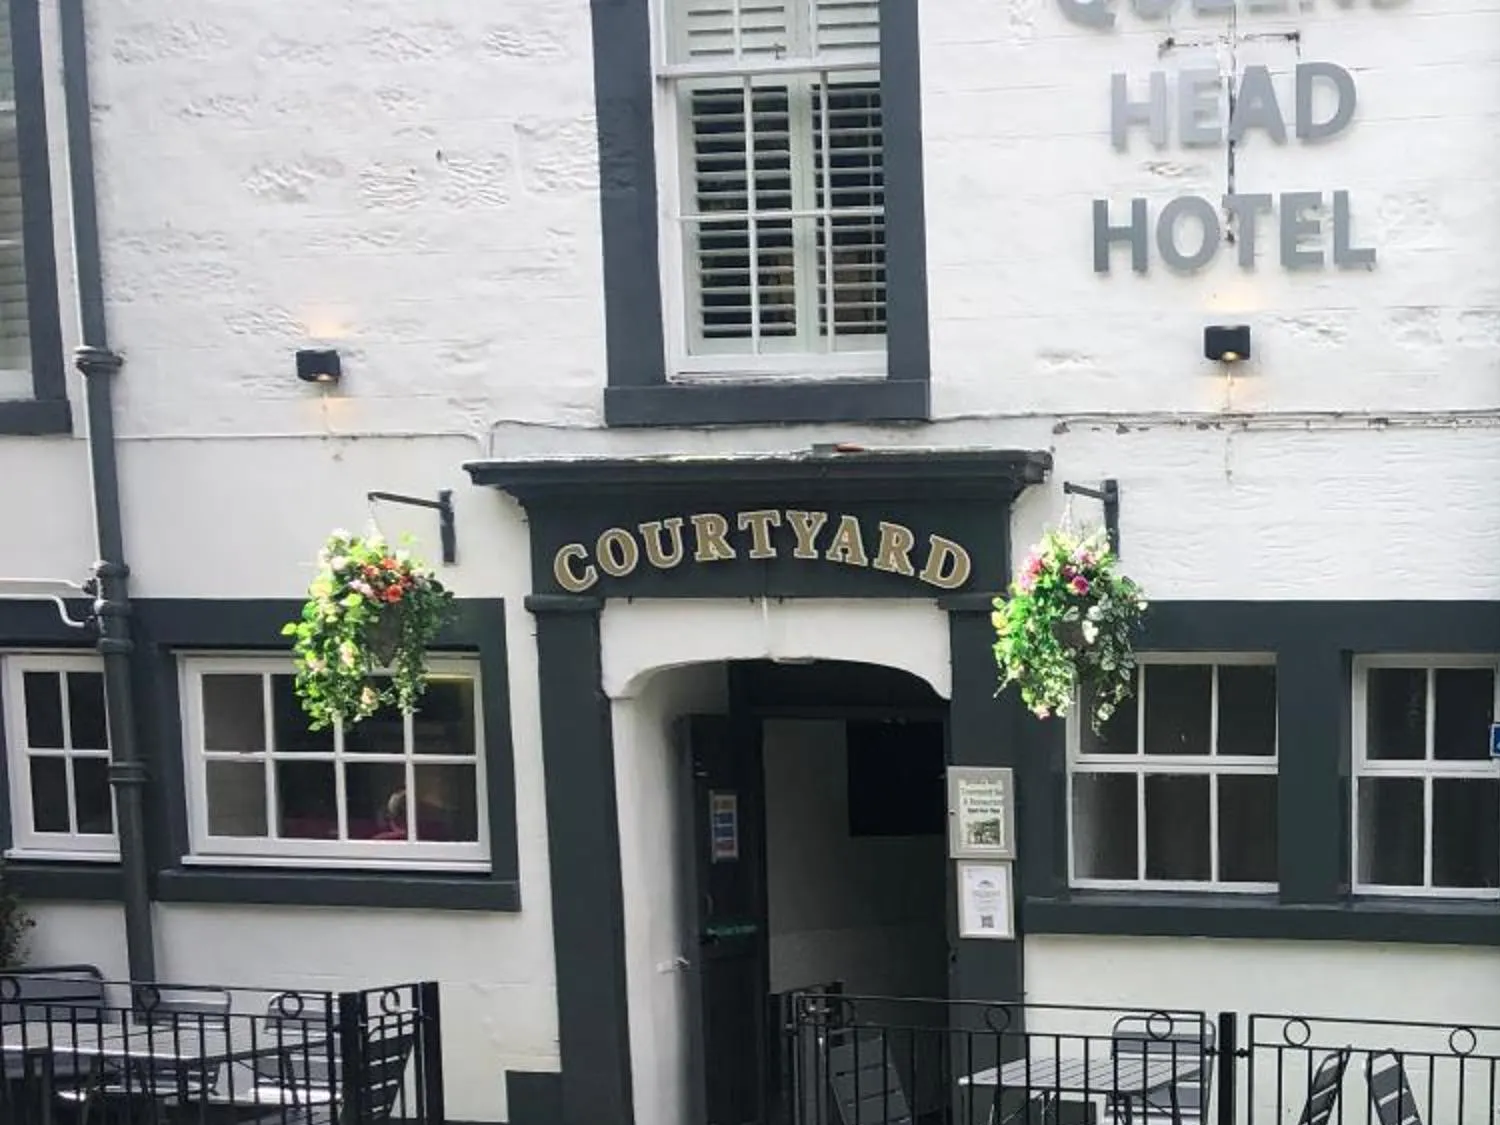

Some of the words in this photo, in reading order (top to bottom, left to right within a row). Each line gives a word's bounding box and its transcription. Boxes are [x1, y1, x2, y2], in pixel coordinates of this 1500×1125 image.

[1110, 61, 1358, 149] HEAD
[1092, 190, 1377, 273] HOTEL
[553, 508, 972, 593] COURTYARD
